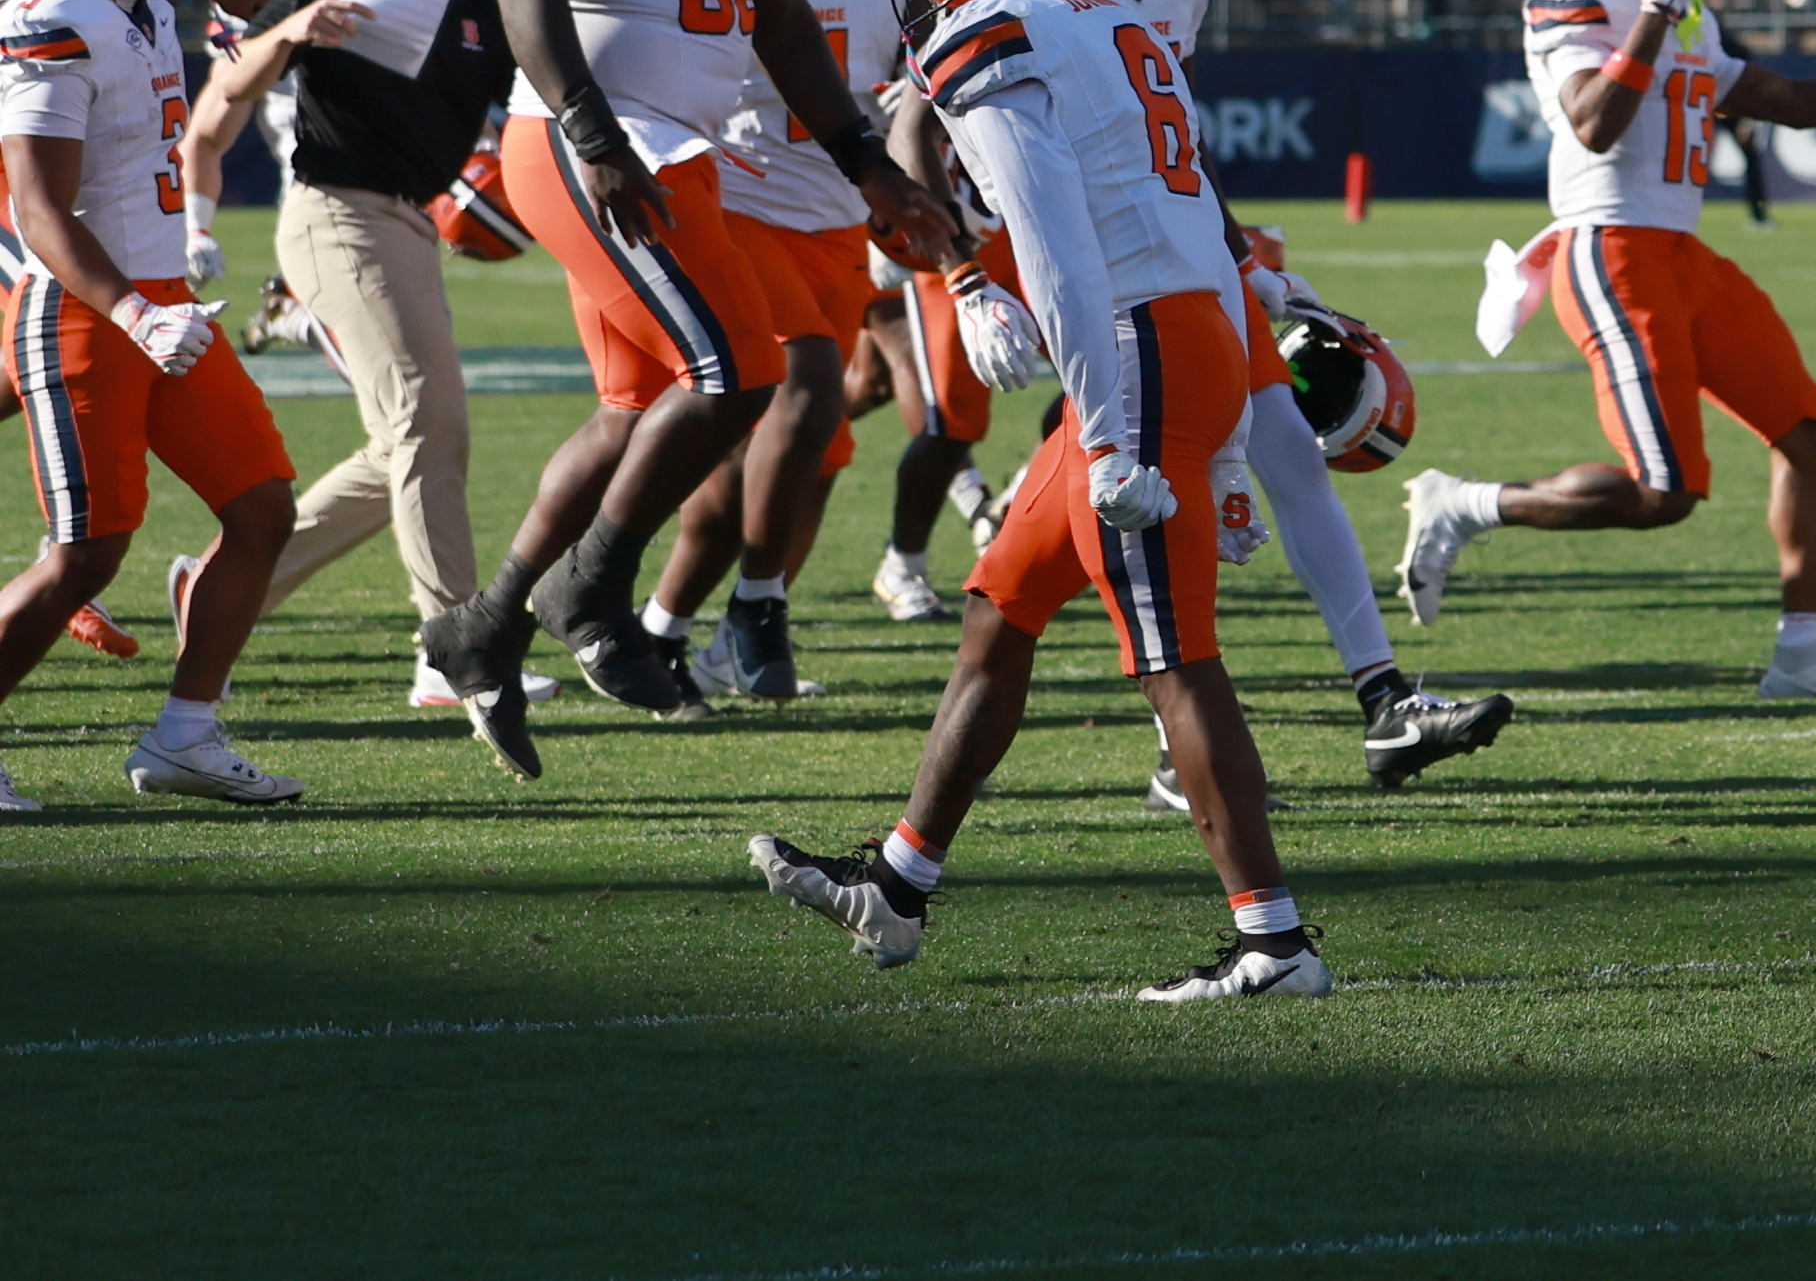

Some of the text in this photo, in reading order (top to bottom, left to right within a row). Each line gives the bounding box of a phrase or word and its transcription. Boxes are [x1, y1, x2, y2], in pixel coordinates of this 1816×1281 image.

[155, 95, 188, 216] 3
[1113, 22, 1201, 198] 6
[1663, 69, 1717, 188] 13
[1222, 492, 1251, 529] S
